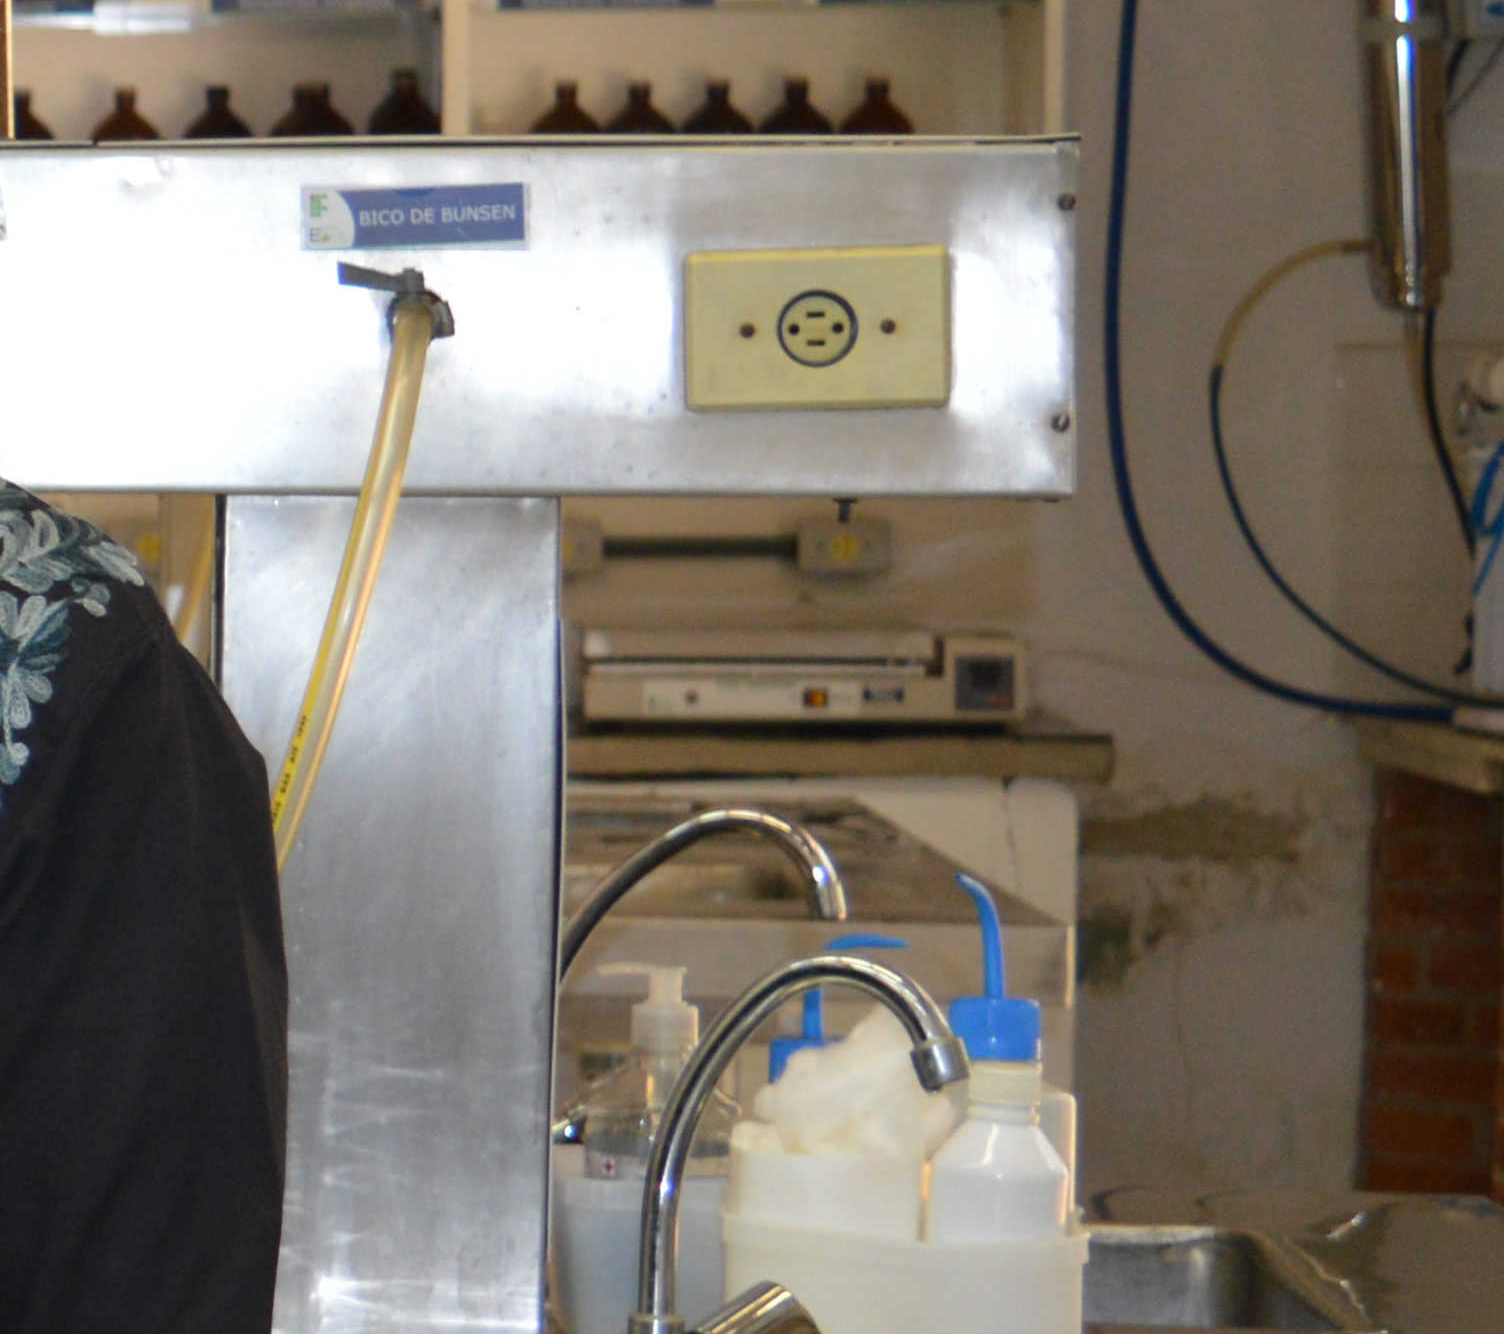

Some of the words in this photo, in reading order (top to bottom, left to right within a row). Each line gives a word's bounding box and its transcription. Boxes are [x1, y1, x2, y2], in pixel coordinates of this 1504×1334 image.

[359, 209, 405, 227] BICO
[410, 207, 435, 224] DE
[440, 203, 516, 223] BUNSEN
